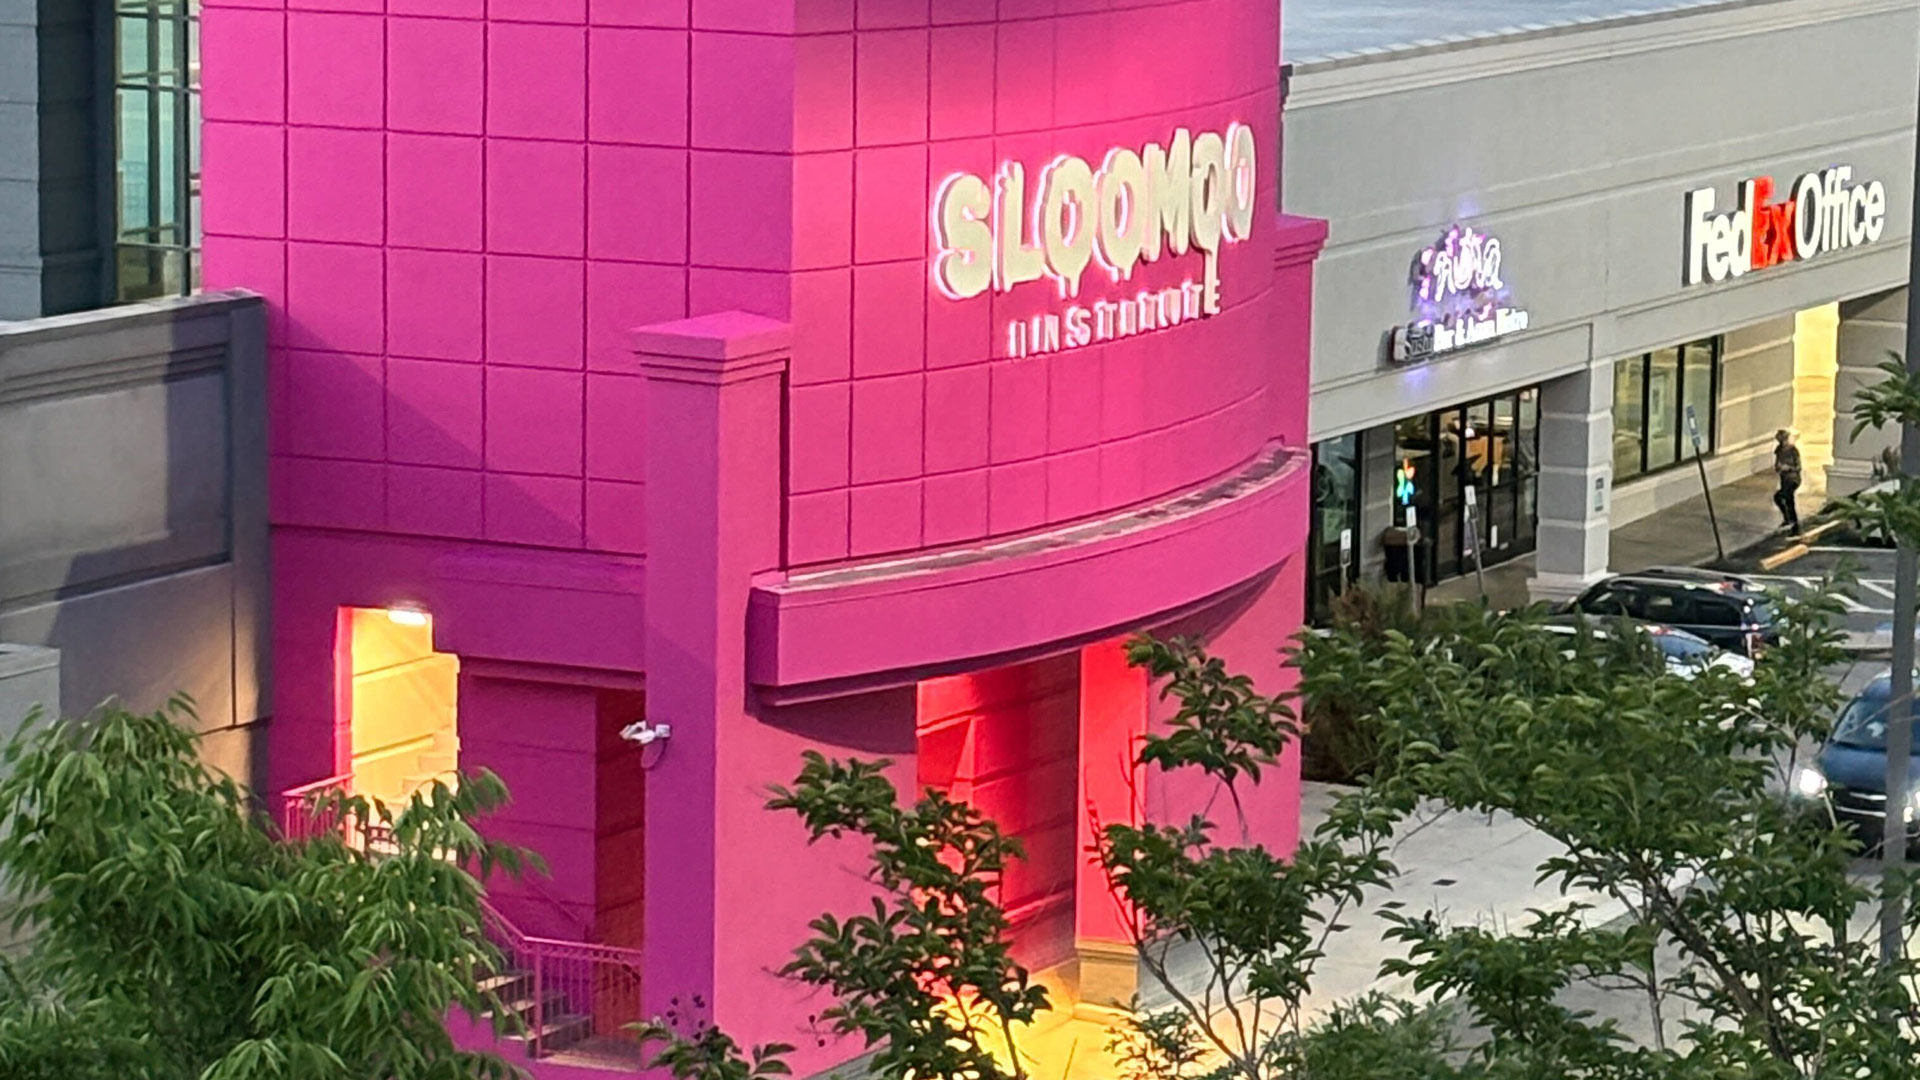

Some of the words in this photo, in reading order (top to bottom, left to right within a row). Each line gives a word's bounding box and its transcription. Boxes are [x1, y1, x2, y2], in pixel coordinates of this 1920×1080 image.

[937, 122, 1255, 298] SLOOMOO
[1689, 175, 1795, 285] FedEx
[1795, 165, 1886, 260] Office
[1009, 279, 1221, 358] INSTITUTE
